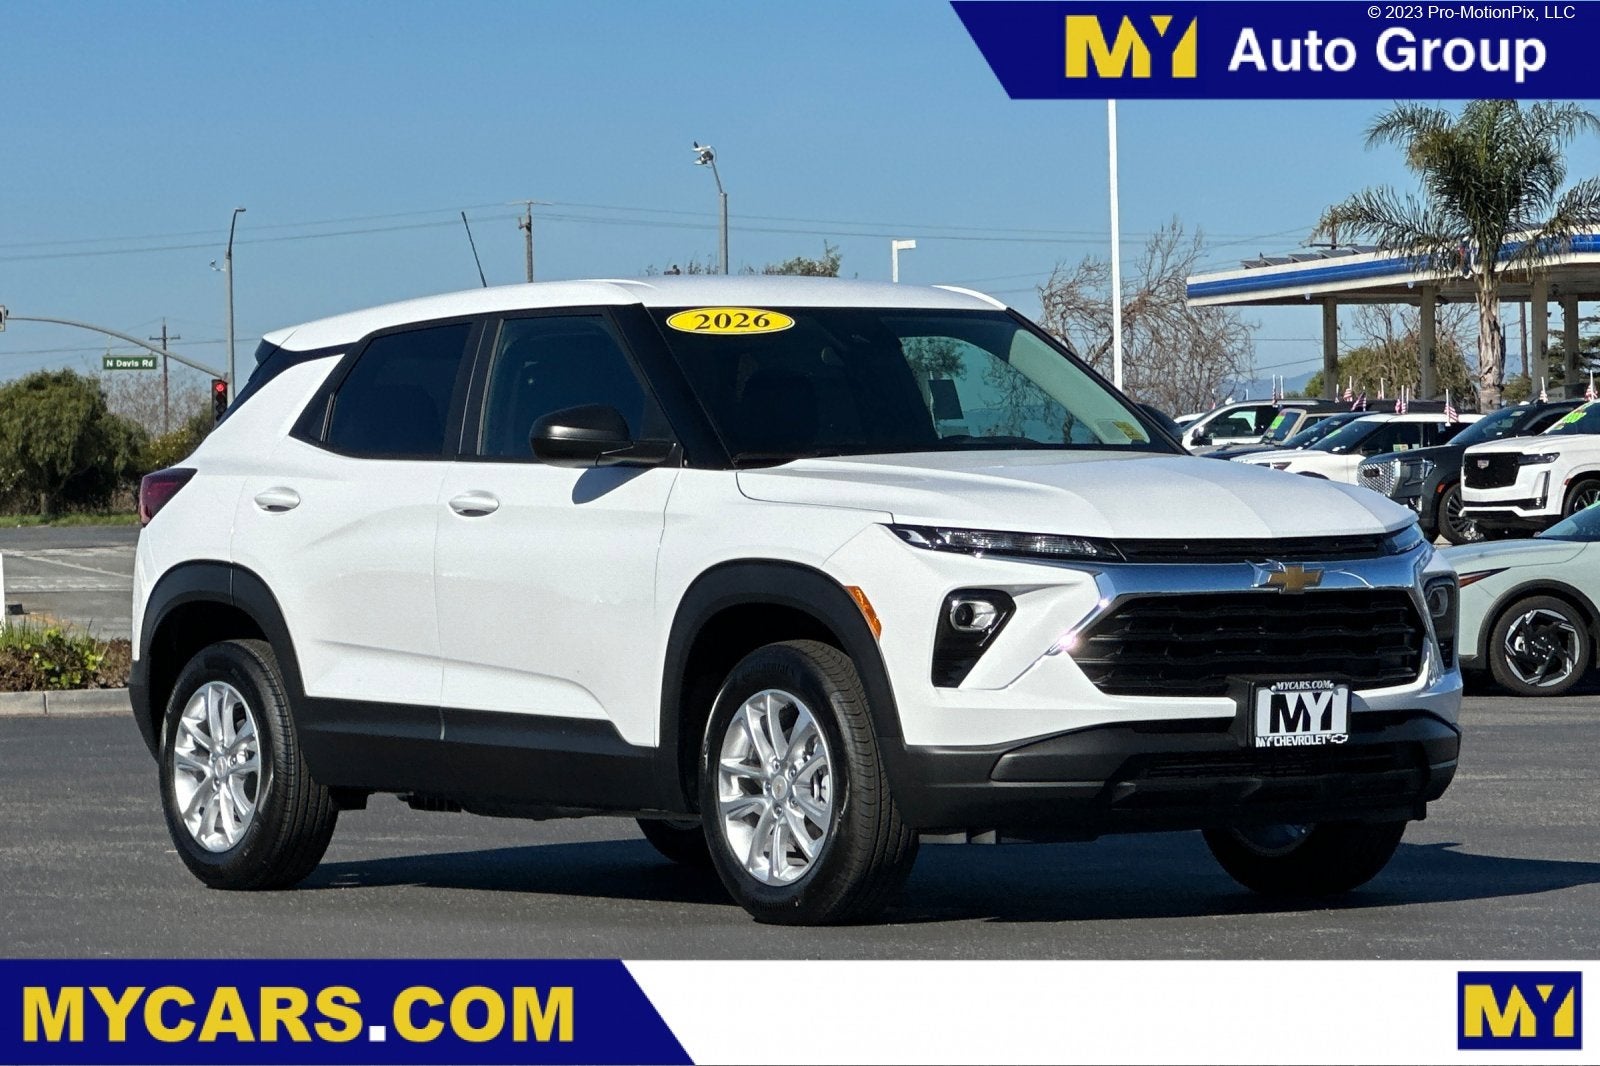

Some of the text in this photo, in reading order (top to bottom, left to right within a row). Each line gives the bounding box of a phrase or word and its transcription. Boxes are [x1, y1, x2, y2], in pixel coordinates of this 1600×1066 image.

[694, 312, 771, 330] 2026
[106, 359, 154, 368] N Davis Rd
[1275, 680, 1331, 690] MYCARS.COM
[1273, 735, 1327, 747] CHEVROLET
